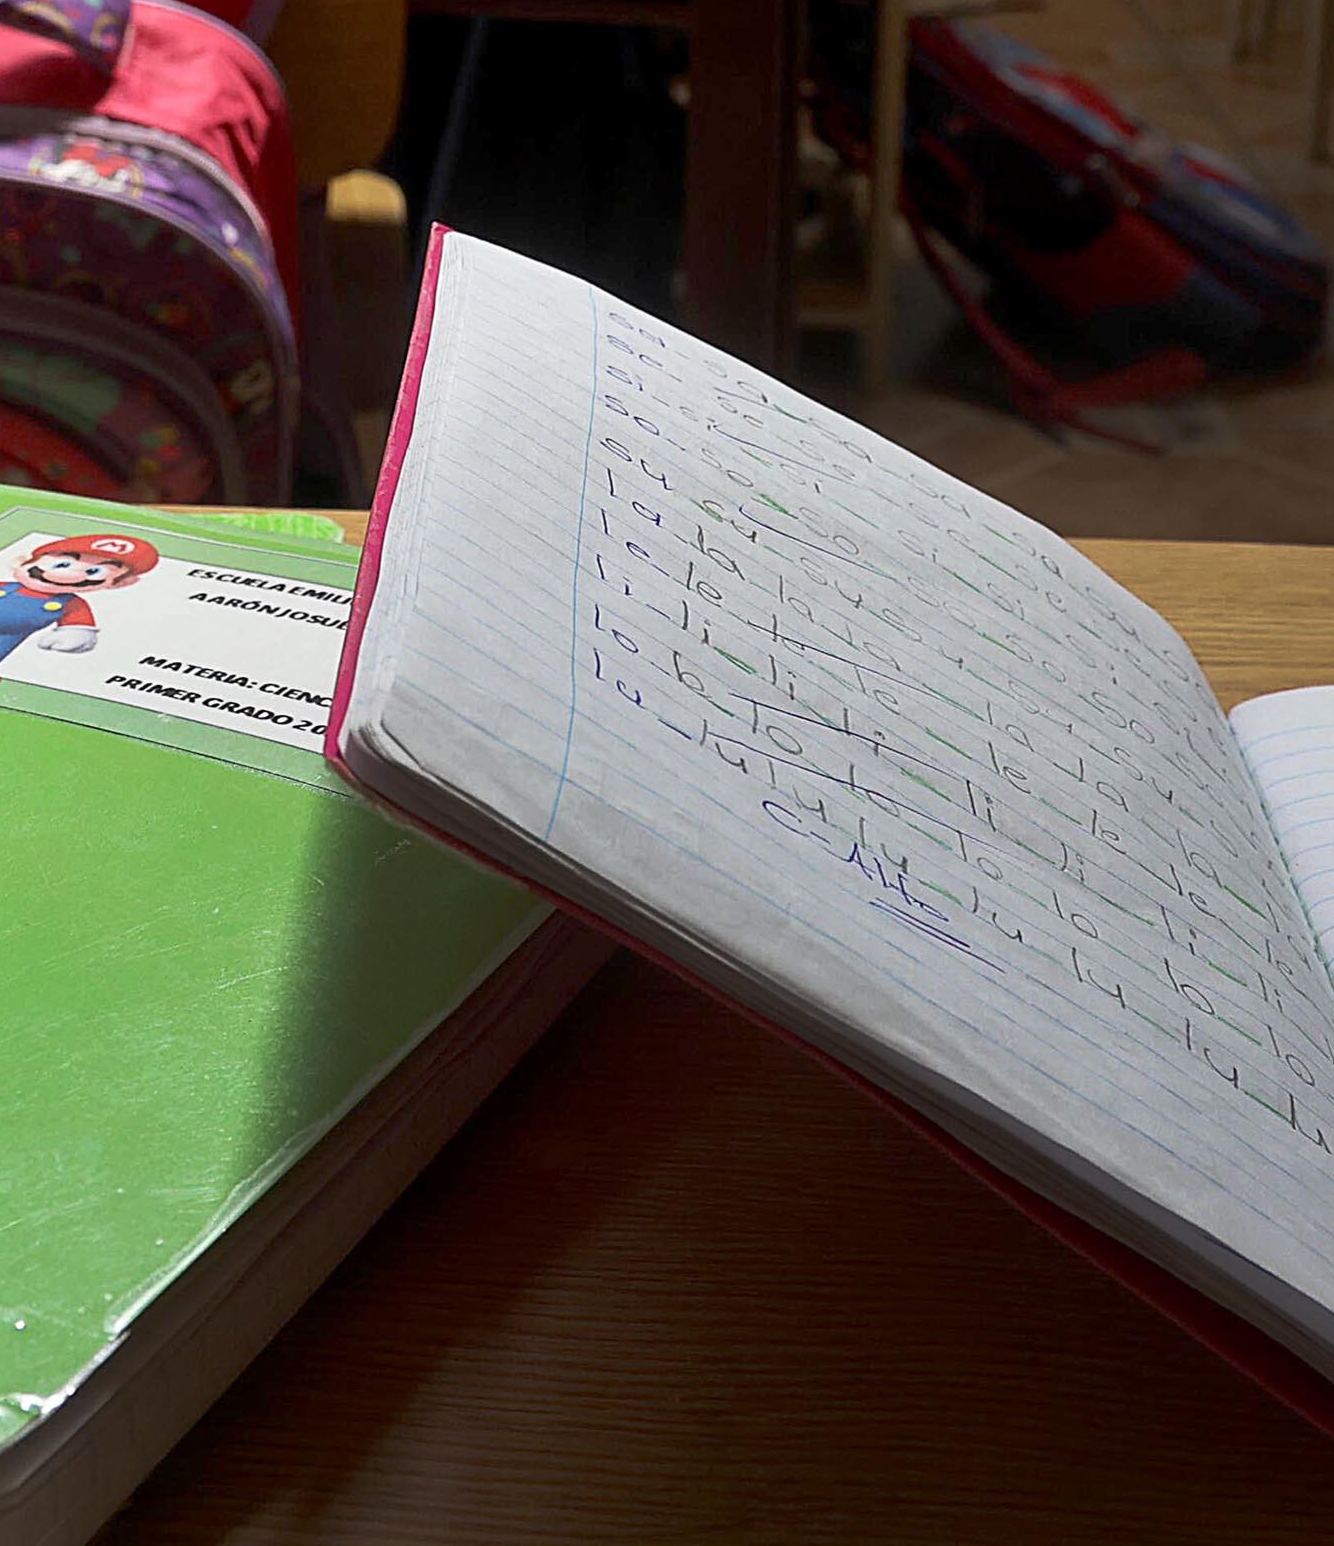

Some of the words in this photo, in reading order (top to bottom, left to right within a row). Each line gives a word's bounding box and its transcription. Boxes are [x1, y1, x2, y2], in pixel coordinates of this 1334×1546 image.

[187, 568, 287, 593] ESCUELA
[288, 586, 354, 606] EMILI
[188, 592, 280, 617] AARÓN
[138, 656, 258, 689] MATERIA:
[105, 674, 202, 704] PRIMER
[202, 697, 294, 726] GRADO
